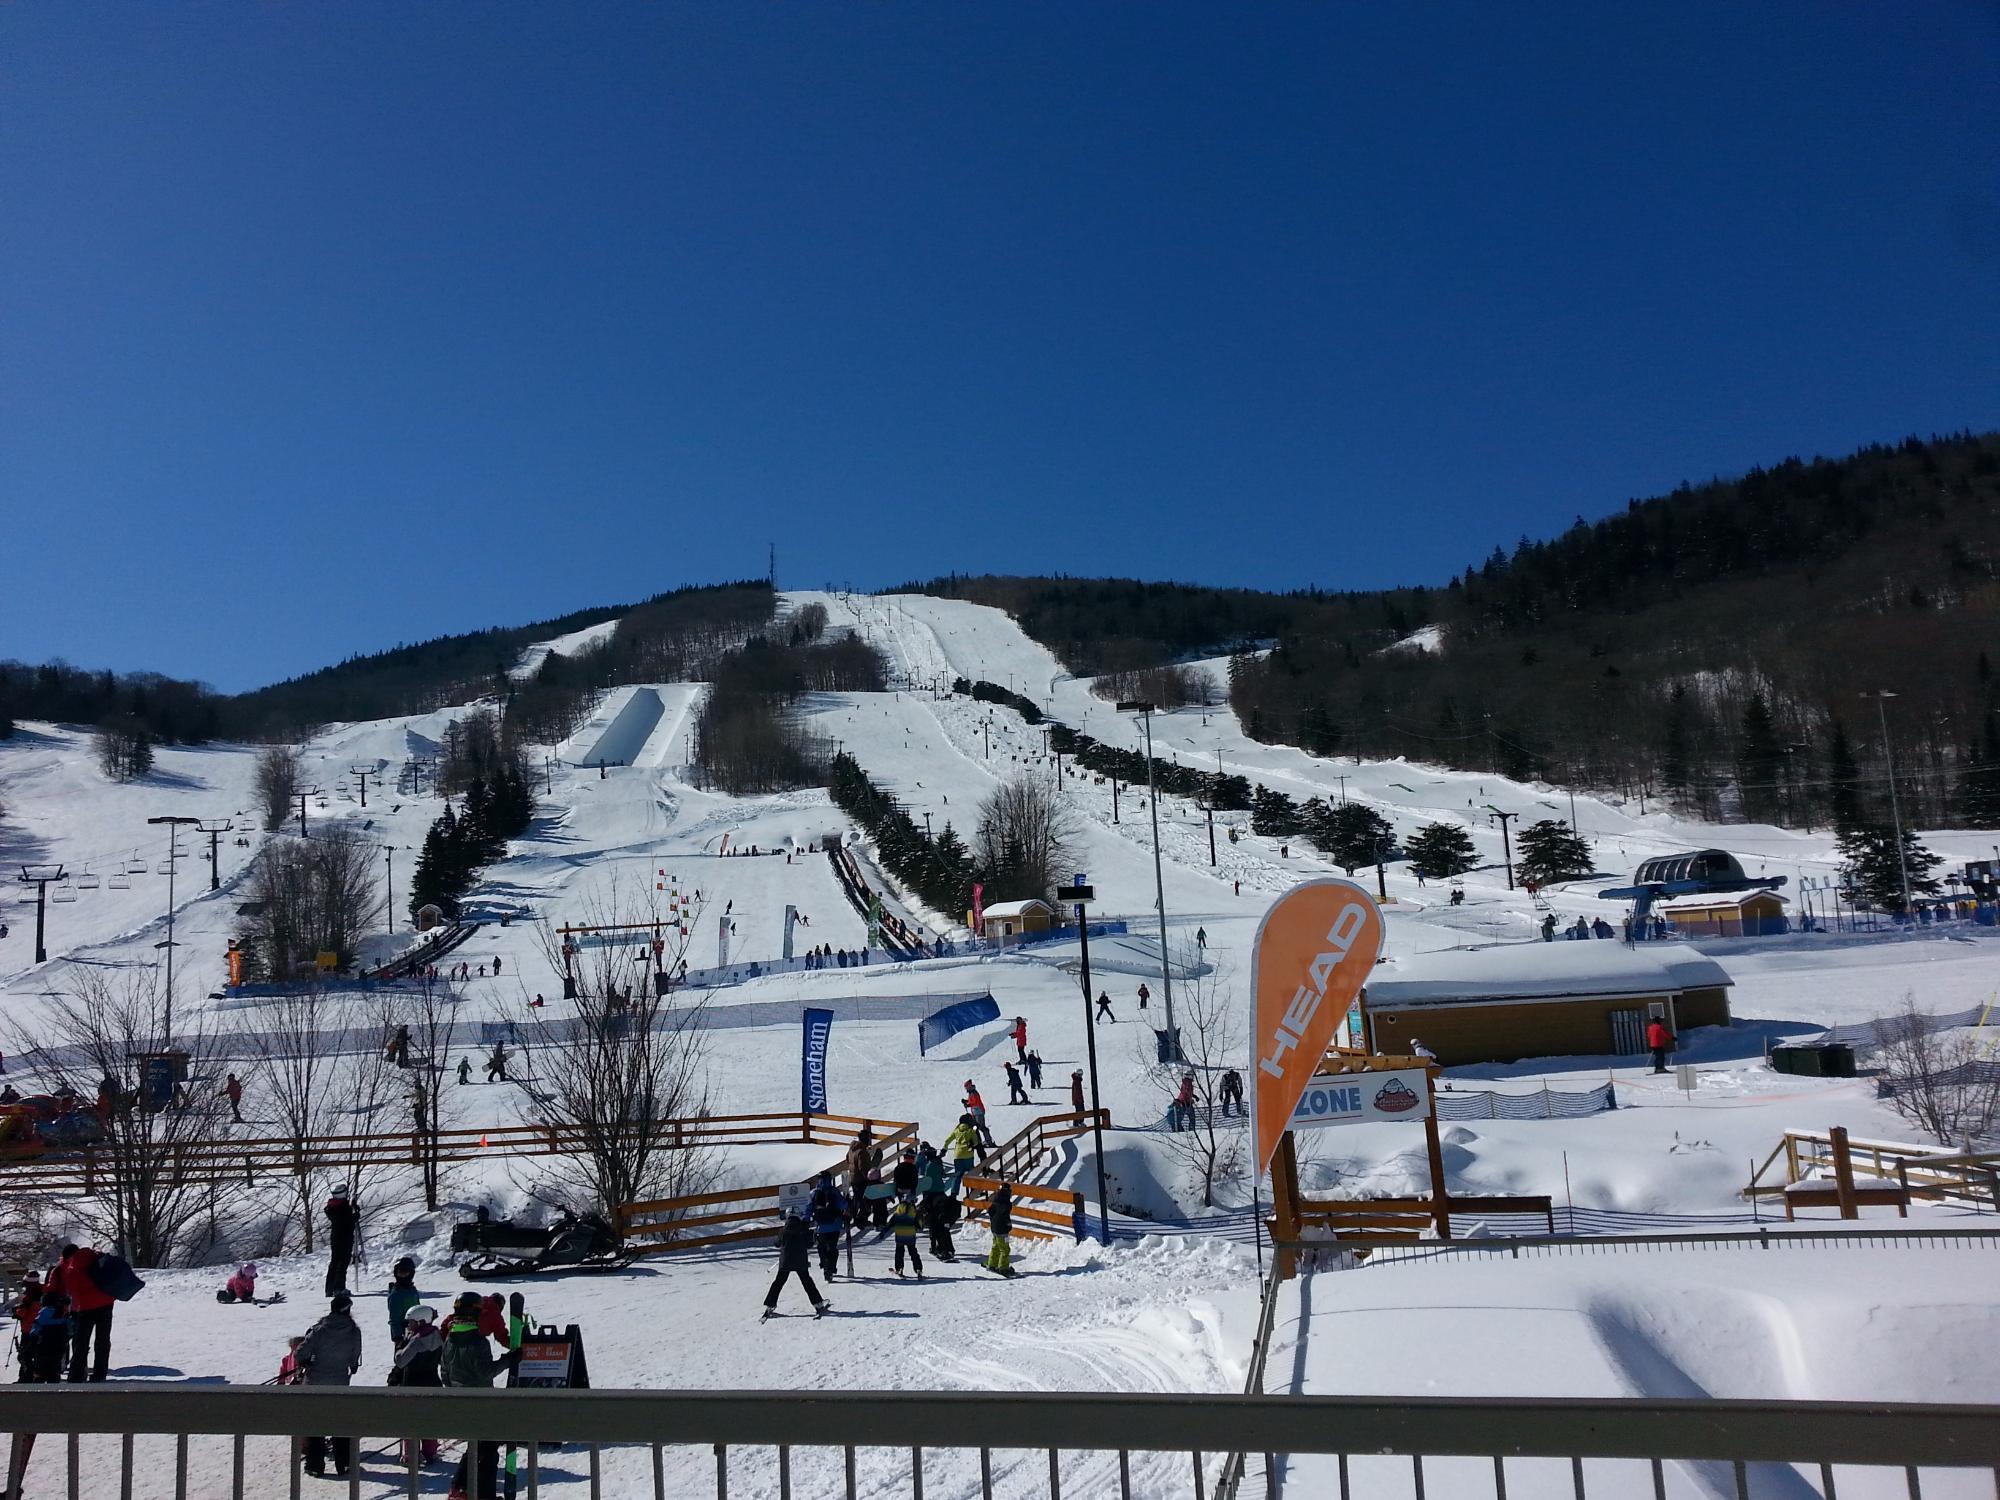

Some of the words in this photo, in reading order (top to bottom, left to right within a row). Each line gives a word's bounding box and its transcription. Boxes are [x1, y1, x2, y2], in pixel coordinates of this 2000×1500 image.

[1259, 903, 1367, 1079] HEAD
[806, 1022, 829, 1109] Stoneham
[1294, 1087, 1362, 1116] ZONE
